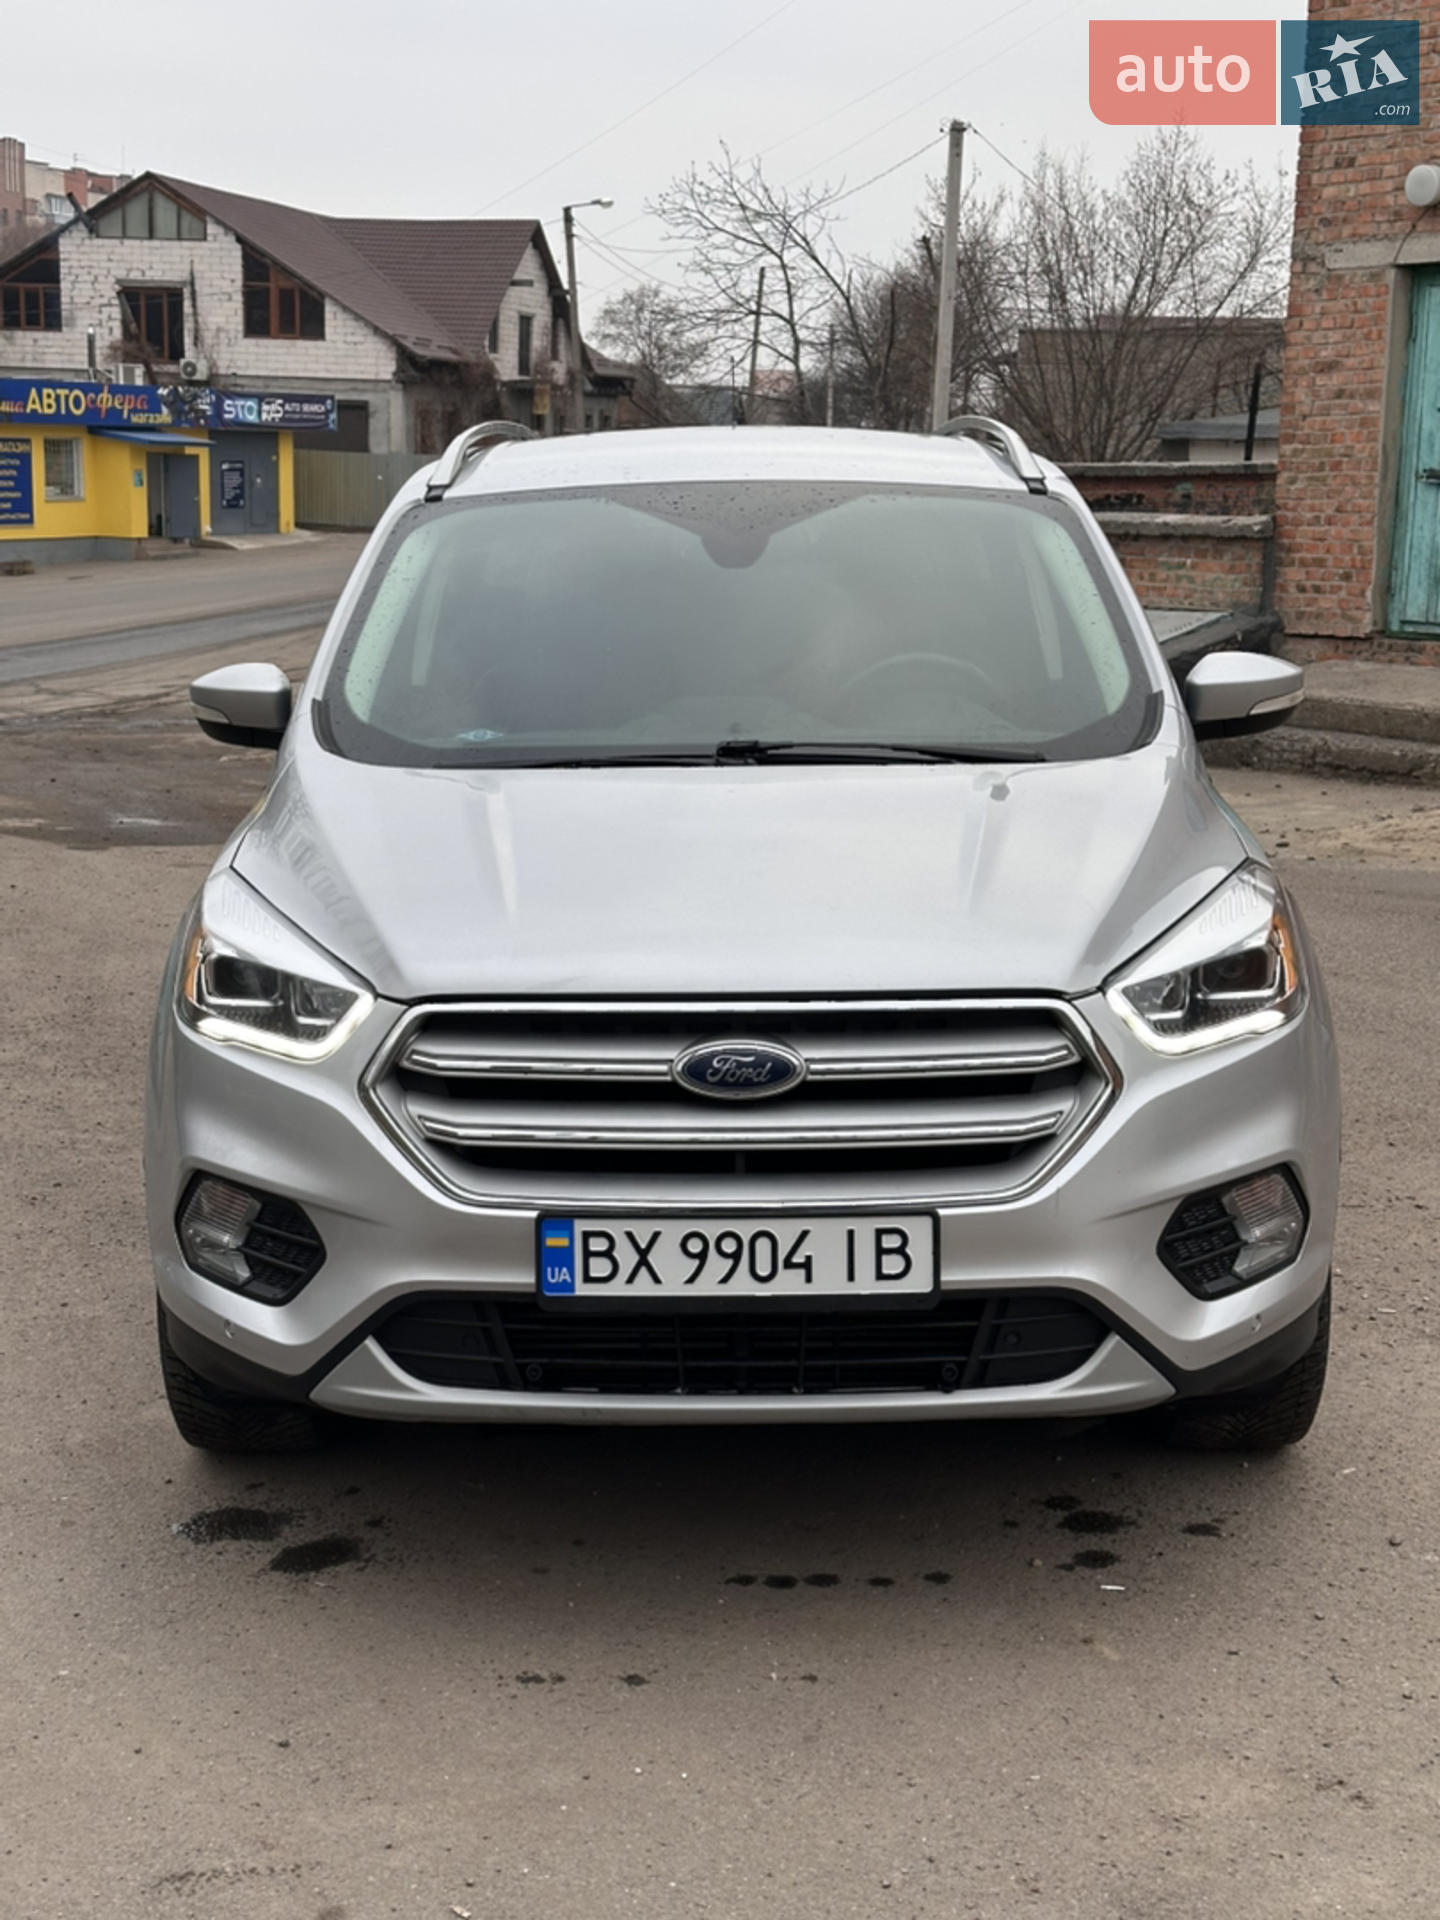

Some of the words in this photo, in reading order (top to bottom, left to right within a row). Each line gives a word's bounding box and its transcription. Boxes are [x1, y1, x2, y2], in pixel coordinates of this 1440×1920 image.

[131, 413, 172, 424] магазин
[706, 1055, 772, 1083] Ford
[581, 1230, 662, 1285] BX
[679, 1230, 813, 1284] 9904
[547, 1267, 571, 1283] UA
